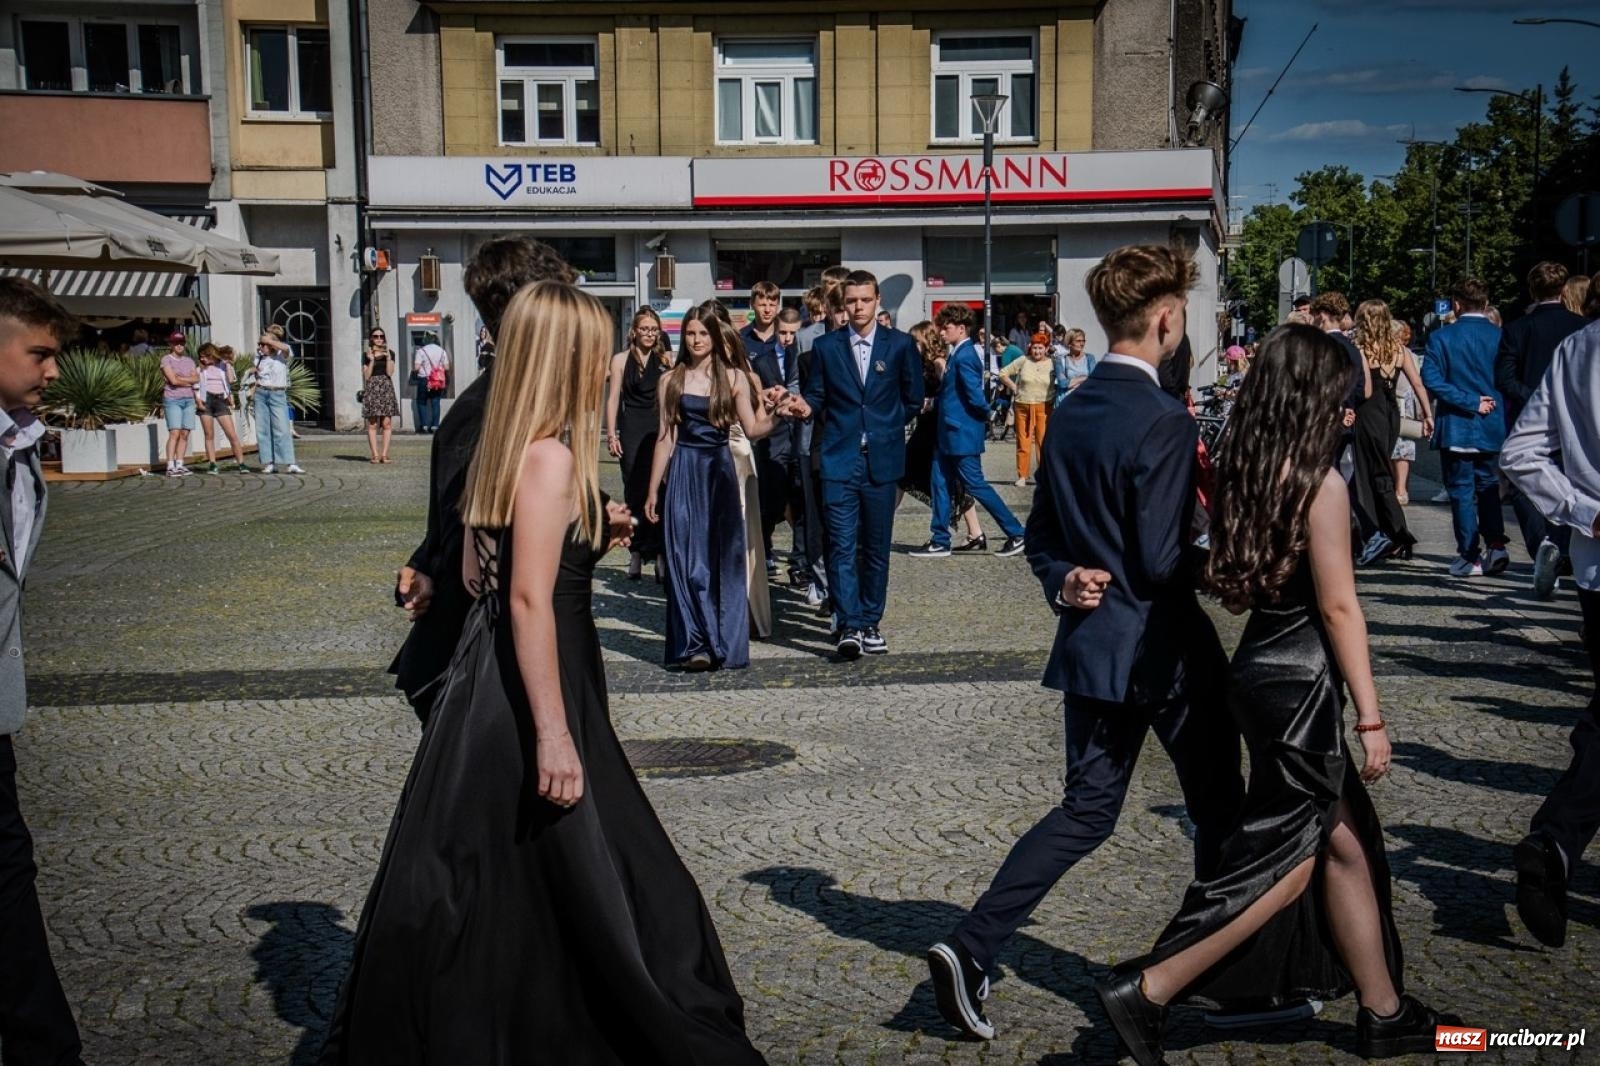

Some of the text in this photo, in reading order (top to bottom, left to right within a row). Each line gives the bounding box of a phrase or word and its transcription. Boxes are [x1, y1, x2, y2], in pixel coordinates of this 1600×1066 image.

[526, 163, 576, 182] TEB
[829, 156, 1067, 192] ROSSMANN
[526, 186, 577, 195] EDUKACJA
